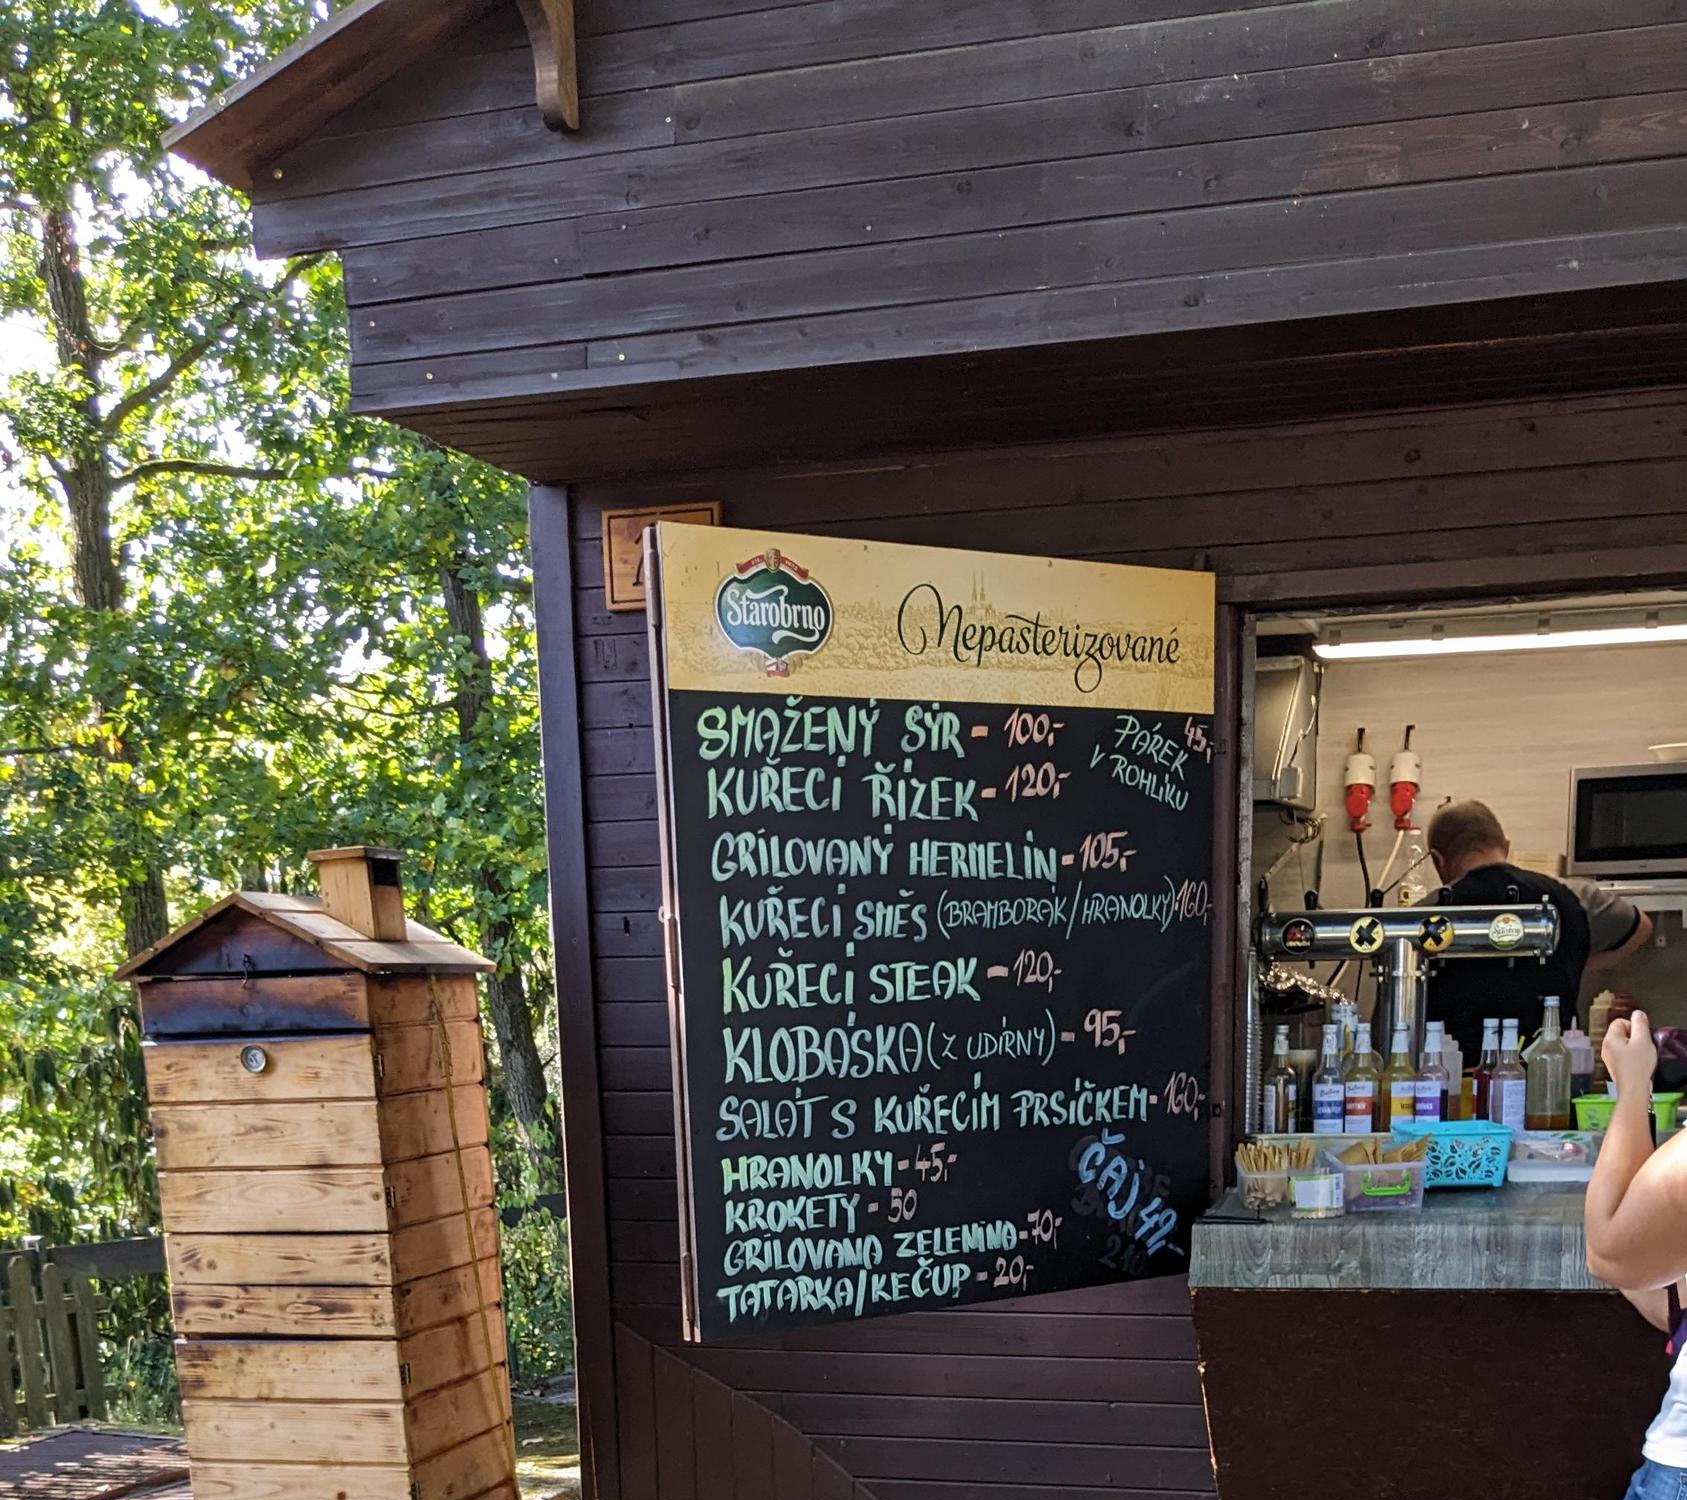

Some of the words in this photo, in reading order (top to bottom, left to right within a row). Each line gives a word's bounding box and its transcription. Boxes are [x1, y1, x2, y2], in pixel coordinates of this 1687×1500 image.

[727, 585, 825, 644] Starobrno
[898, 584, 1180, 693] Nepasterizované
[697, 696, 880, 760] SMAŽENÝ
[901, 703, 965, 758] SÝR
[1114, 715, 1188, 780] PÁREK
[707, 755, 842, 820] KUŘECÍ
[861, 757, 979, 822] ŘÍZEK
[1109, 754, 1189, 811] ROHLÍKU
[909, 830, 1057, 885] HERMELÍN
[853, 889, 928, 942] SMĚS
[869, 957, 982, 1005] STEAK
[831, 1099, 857, 1139] S
[721, 1150, 893, 1195] HRANOLKY
[1078, 1127, 1145, 1220] ČAJ
[725, 1193, 861, 1235] KROKETY
[887, 1187, 918, 1223] 50
[893, 1220, 1018, 1258] ZELENINA
